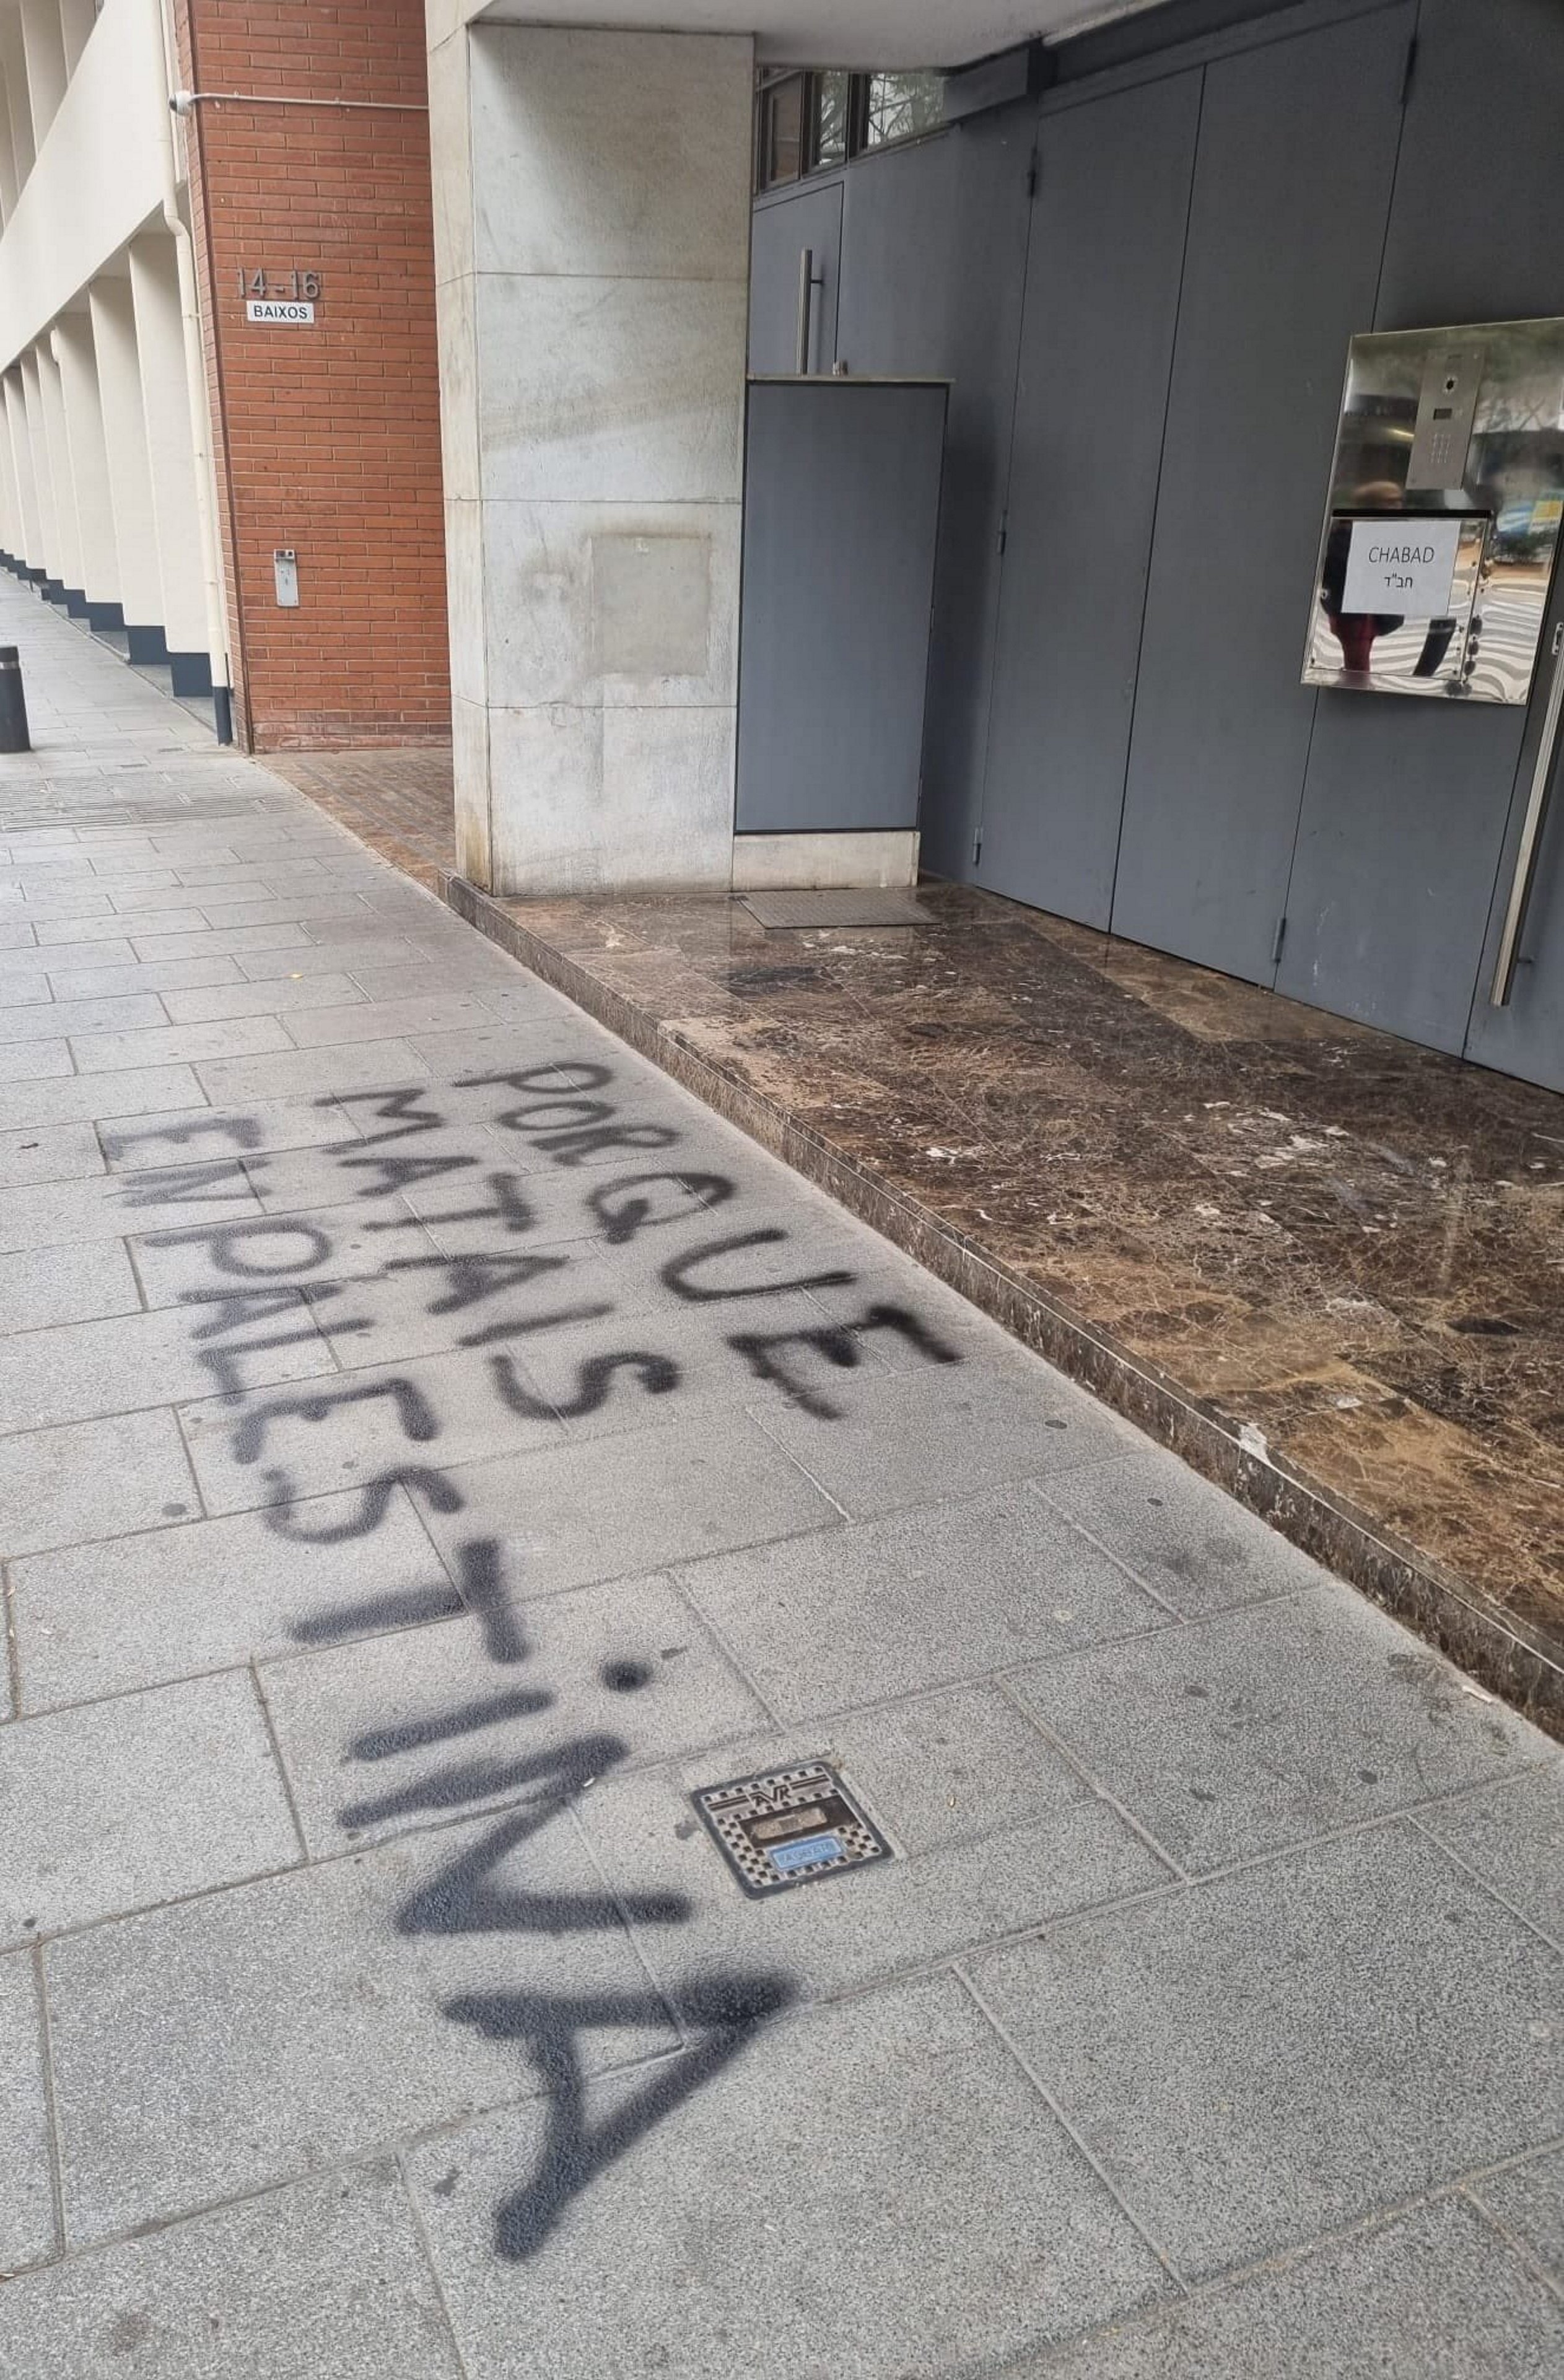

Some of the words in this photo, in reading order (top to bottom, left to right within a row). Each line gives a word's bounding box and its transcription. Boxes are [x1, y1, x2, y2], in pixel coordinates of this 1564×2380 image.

[237, 268, 321, 300] 14-16
[253, 305, 308, 320] BAIXOS
[1368, 546, 1435, 564] CHABAD
[103, 1116, 274, 1208] EN
[312, 1088, 680, 1422] MATAIS
[451, 1062, 964, 1421] PORQUE
